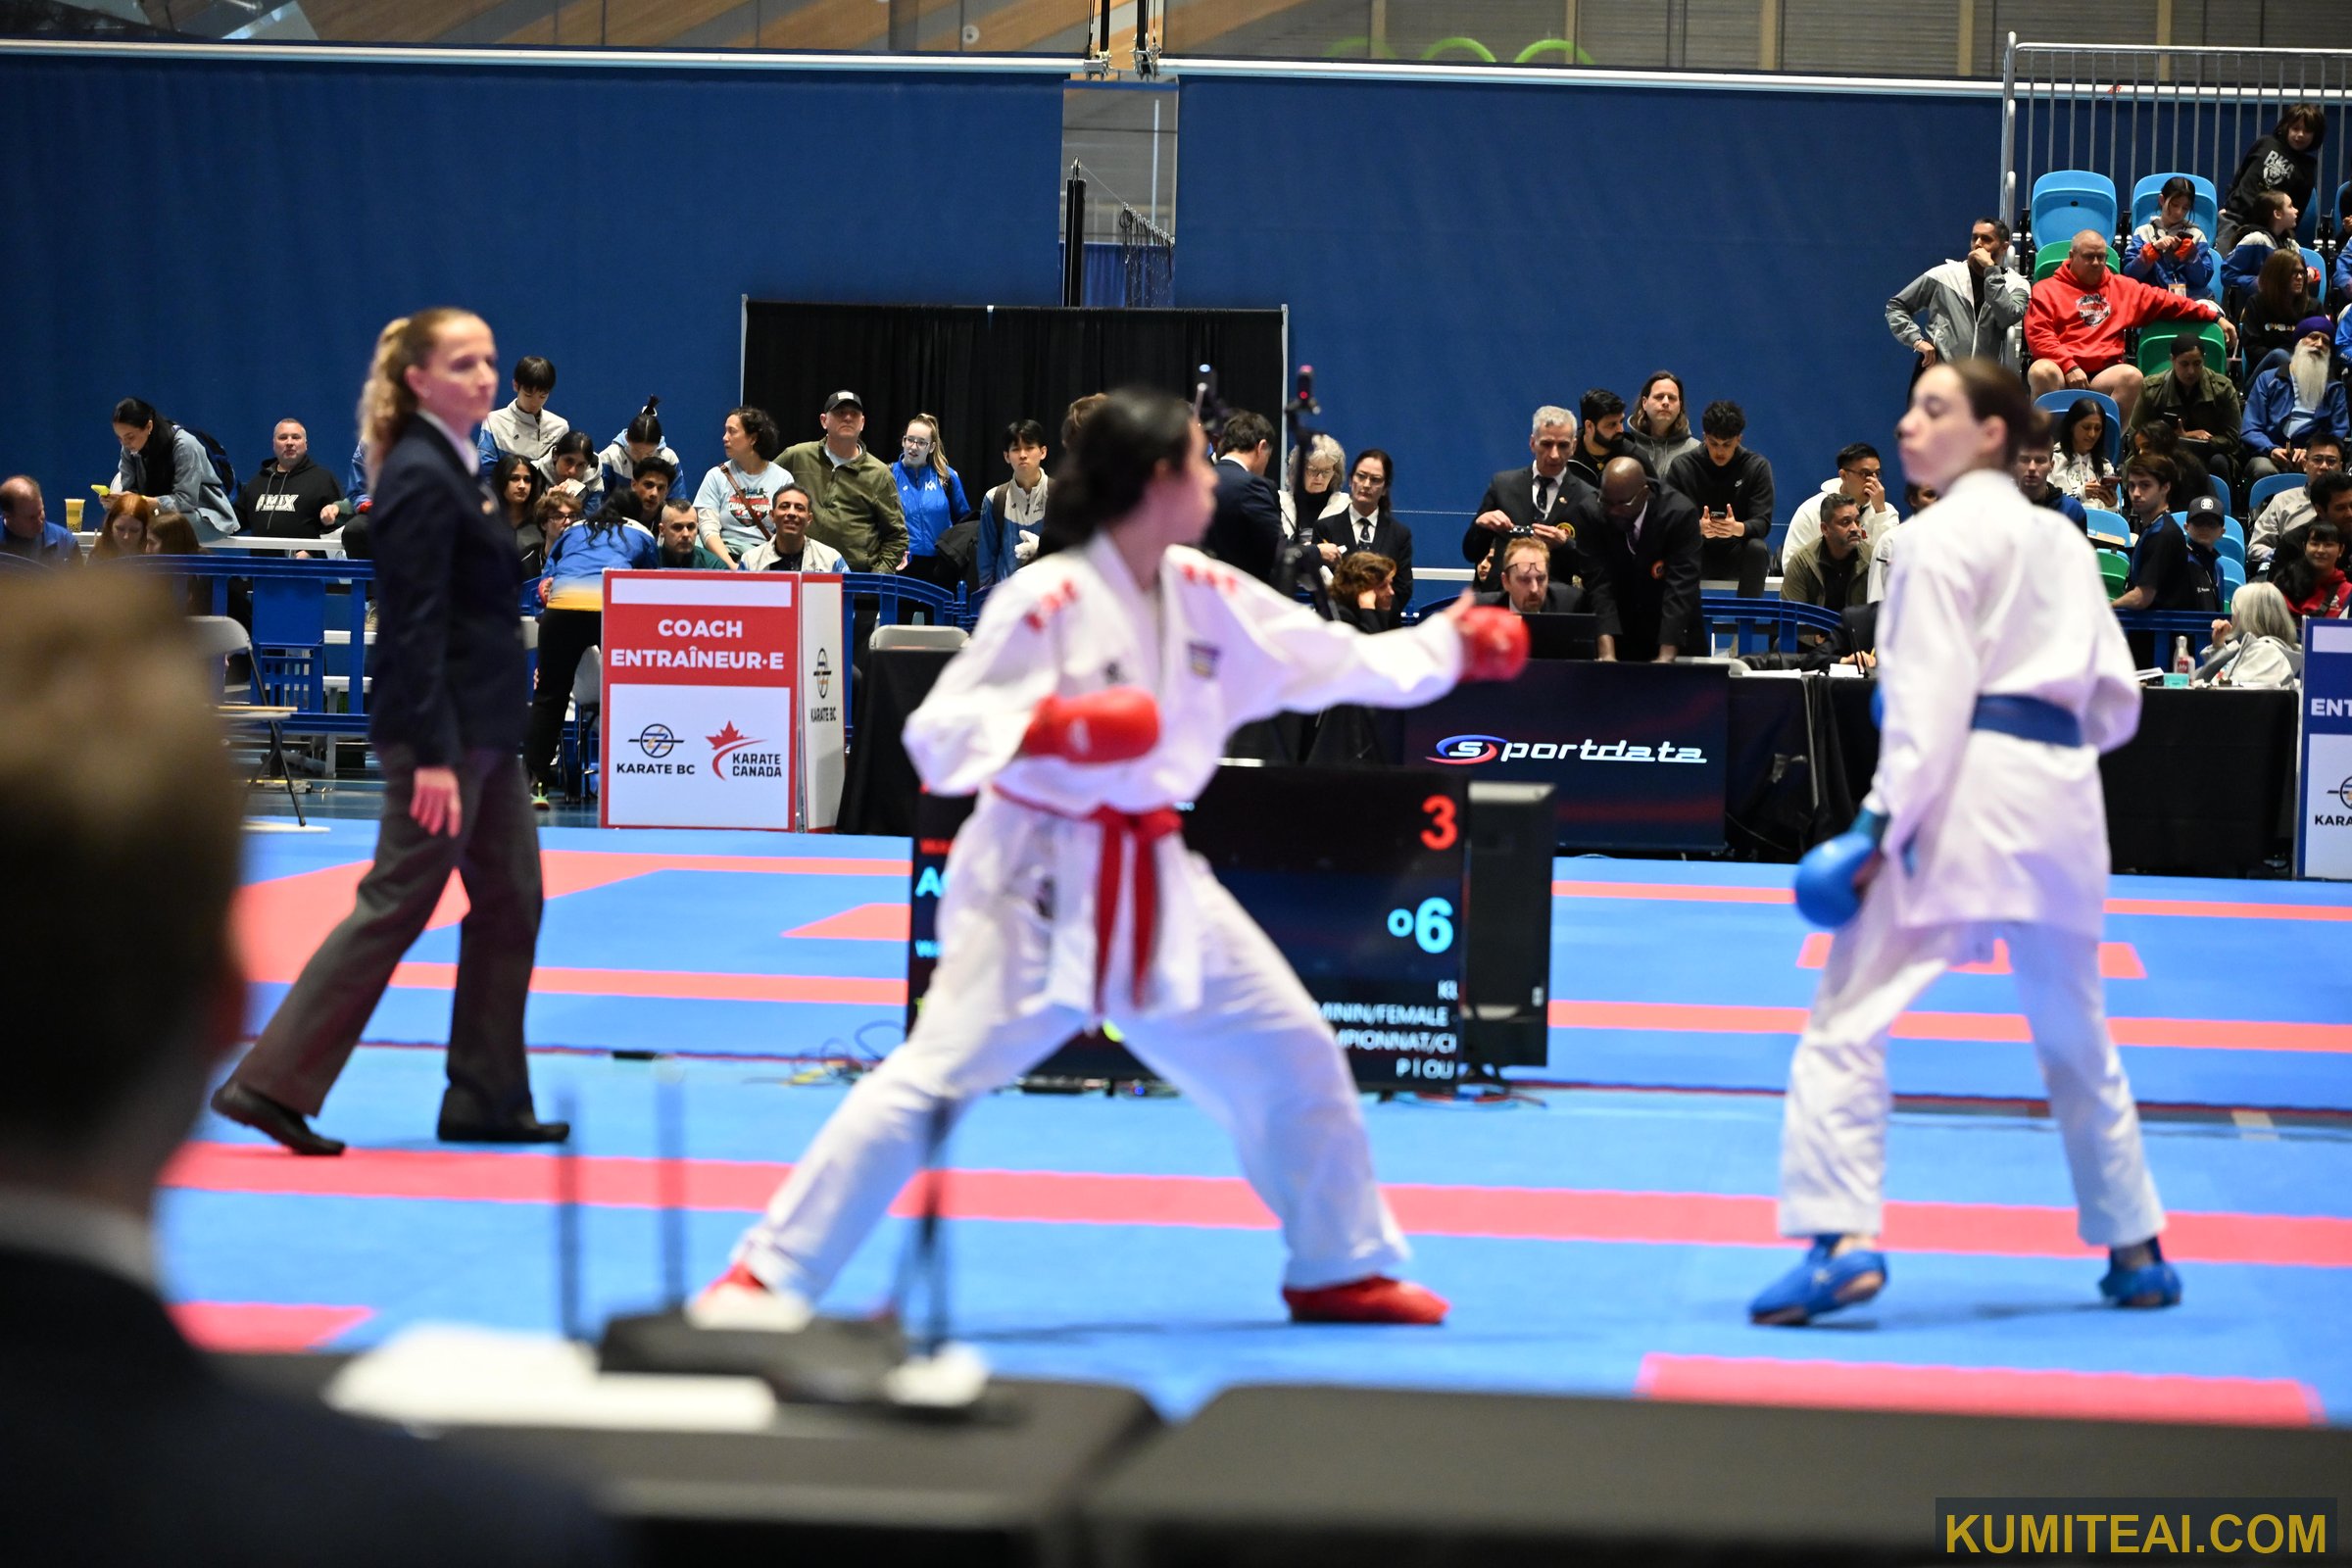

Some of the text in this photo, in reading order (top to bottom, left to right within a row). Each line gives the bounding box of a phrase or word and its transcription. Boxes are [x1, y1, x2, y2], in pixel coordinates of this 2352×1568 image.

[658, 619, 743, 638] COACH
[732, 754, 781, 765] KARATE
[616, 763, 695, 775] KARATE BC
[732, 765, 782, 777] CANADA
[1421, 795, 1457, 851] 3
